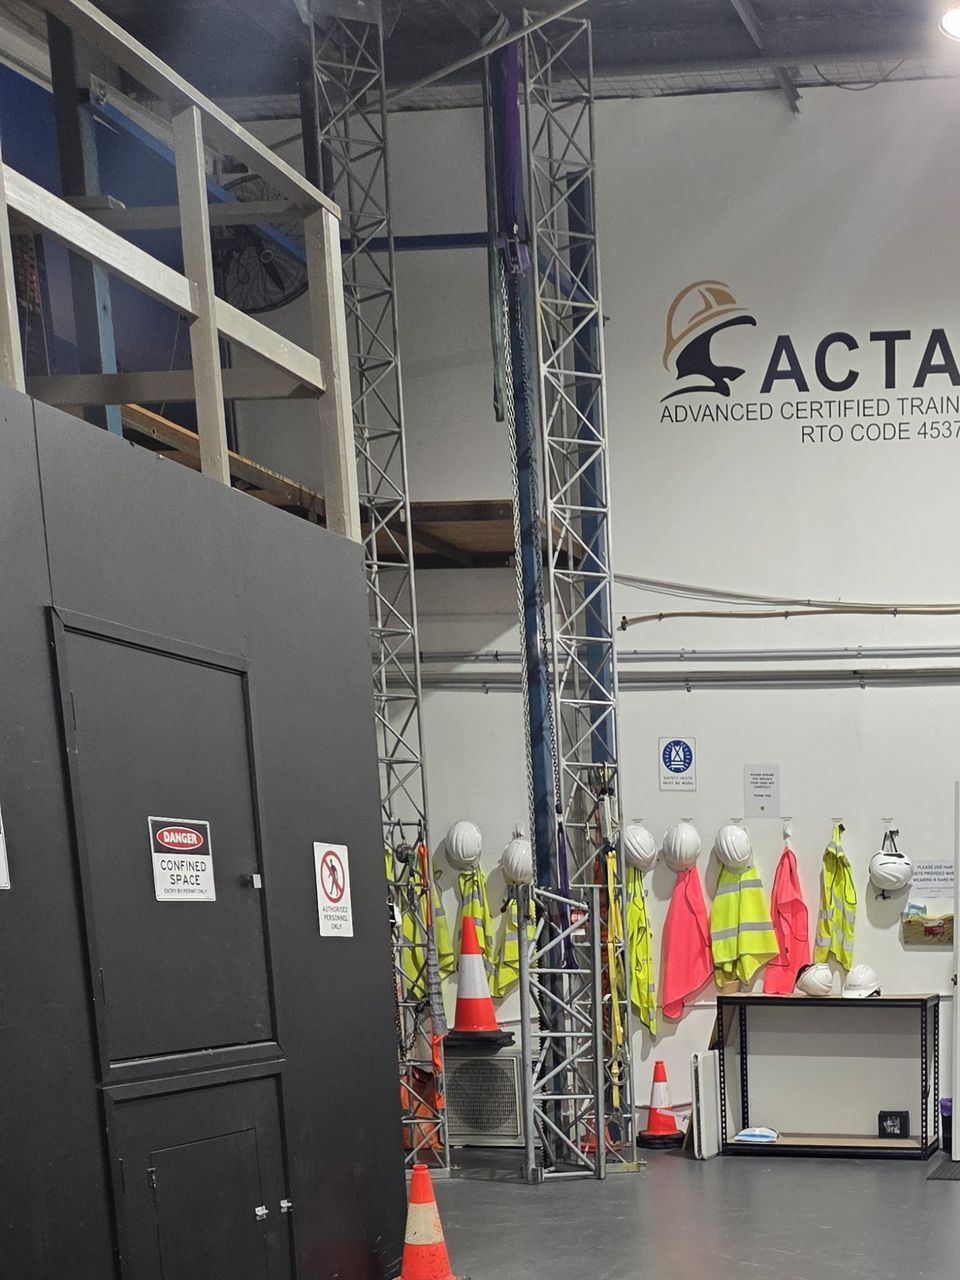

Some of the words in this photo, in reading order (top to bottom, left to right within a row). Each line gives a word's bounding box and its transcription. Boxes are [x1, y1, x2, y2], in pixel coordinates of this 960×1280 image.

[660, 403, 773, 423] ADVANCED
[780, 398, 890, 420] CERTIFIED
[801, 424, 844, 443] RTO
[850, 421, 911, 442] CODE
[163, 831, 198, 844] DANGER
[160, 859, 207, 872] CONFINED
[169, 874, 201, 886] SPACE
